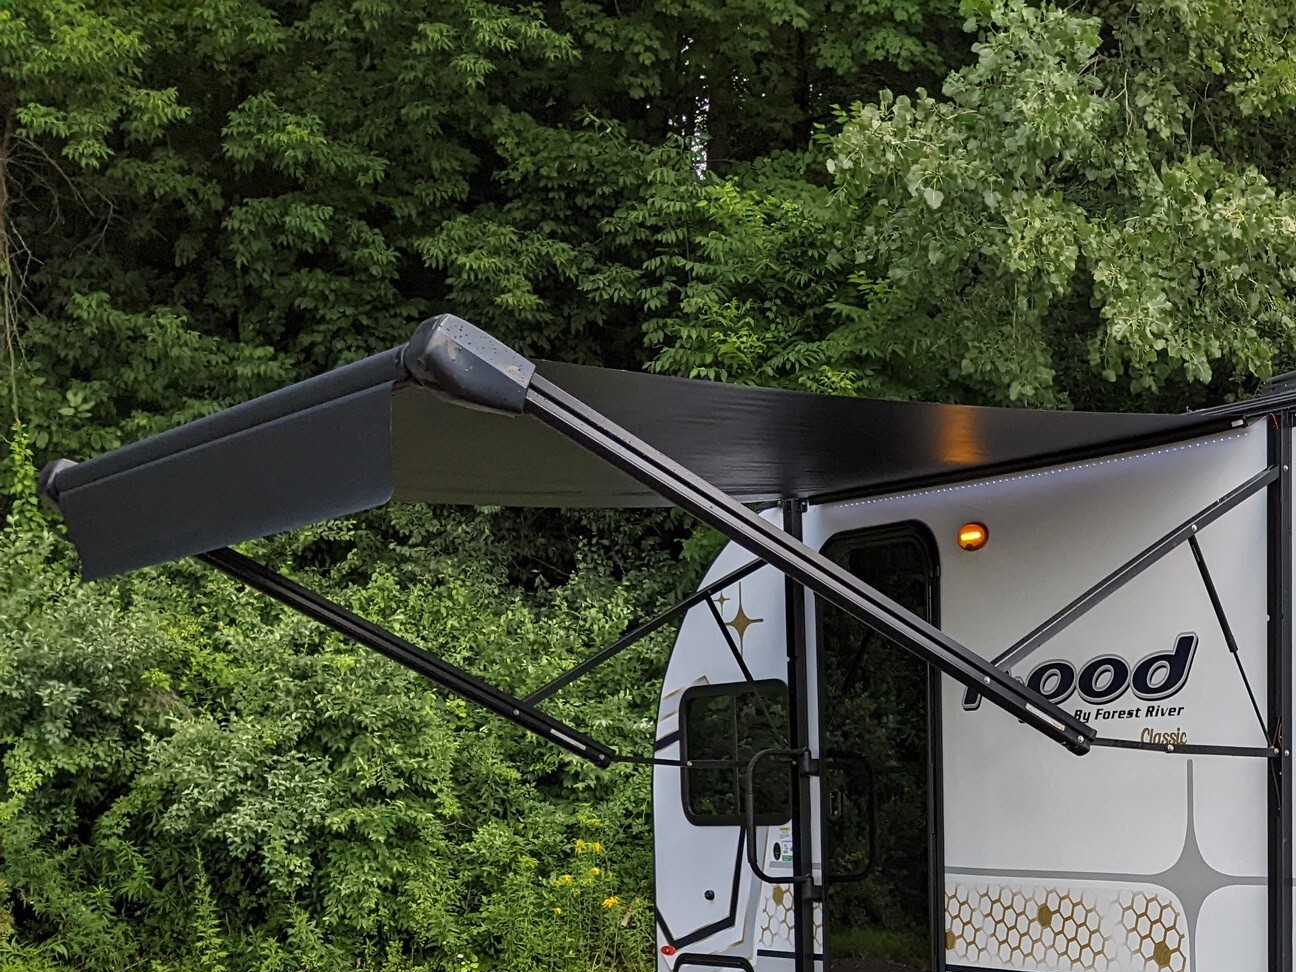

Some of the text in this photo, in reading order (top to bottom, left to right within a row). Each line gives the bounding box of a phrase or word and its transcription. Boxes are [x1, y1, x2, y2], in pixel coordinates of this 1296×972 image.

[1074, 705, 1091, 723] By
[1094, 708, 1141, 720] Forest
[1145, 705, 1184, 717] River
[1140, 727, 1188, 745] Classic
